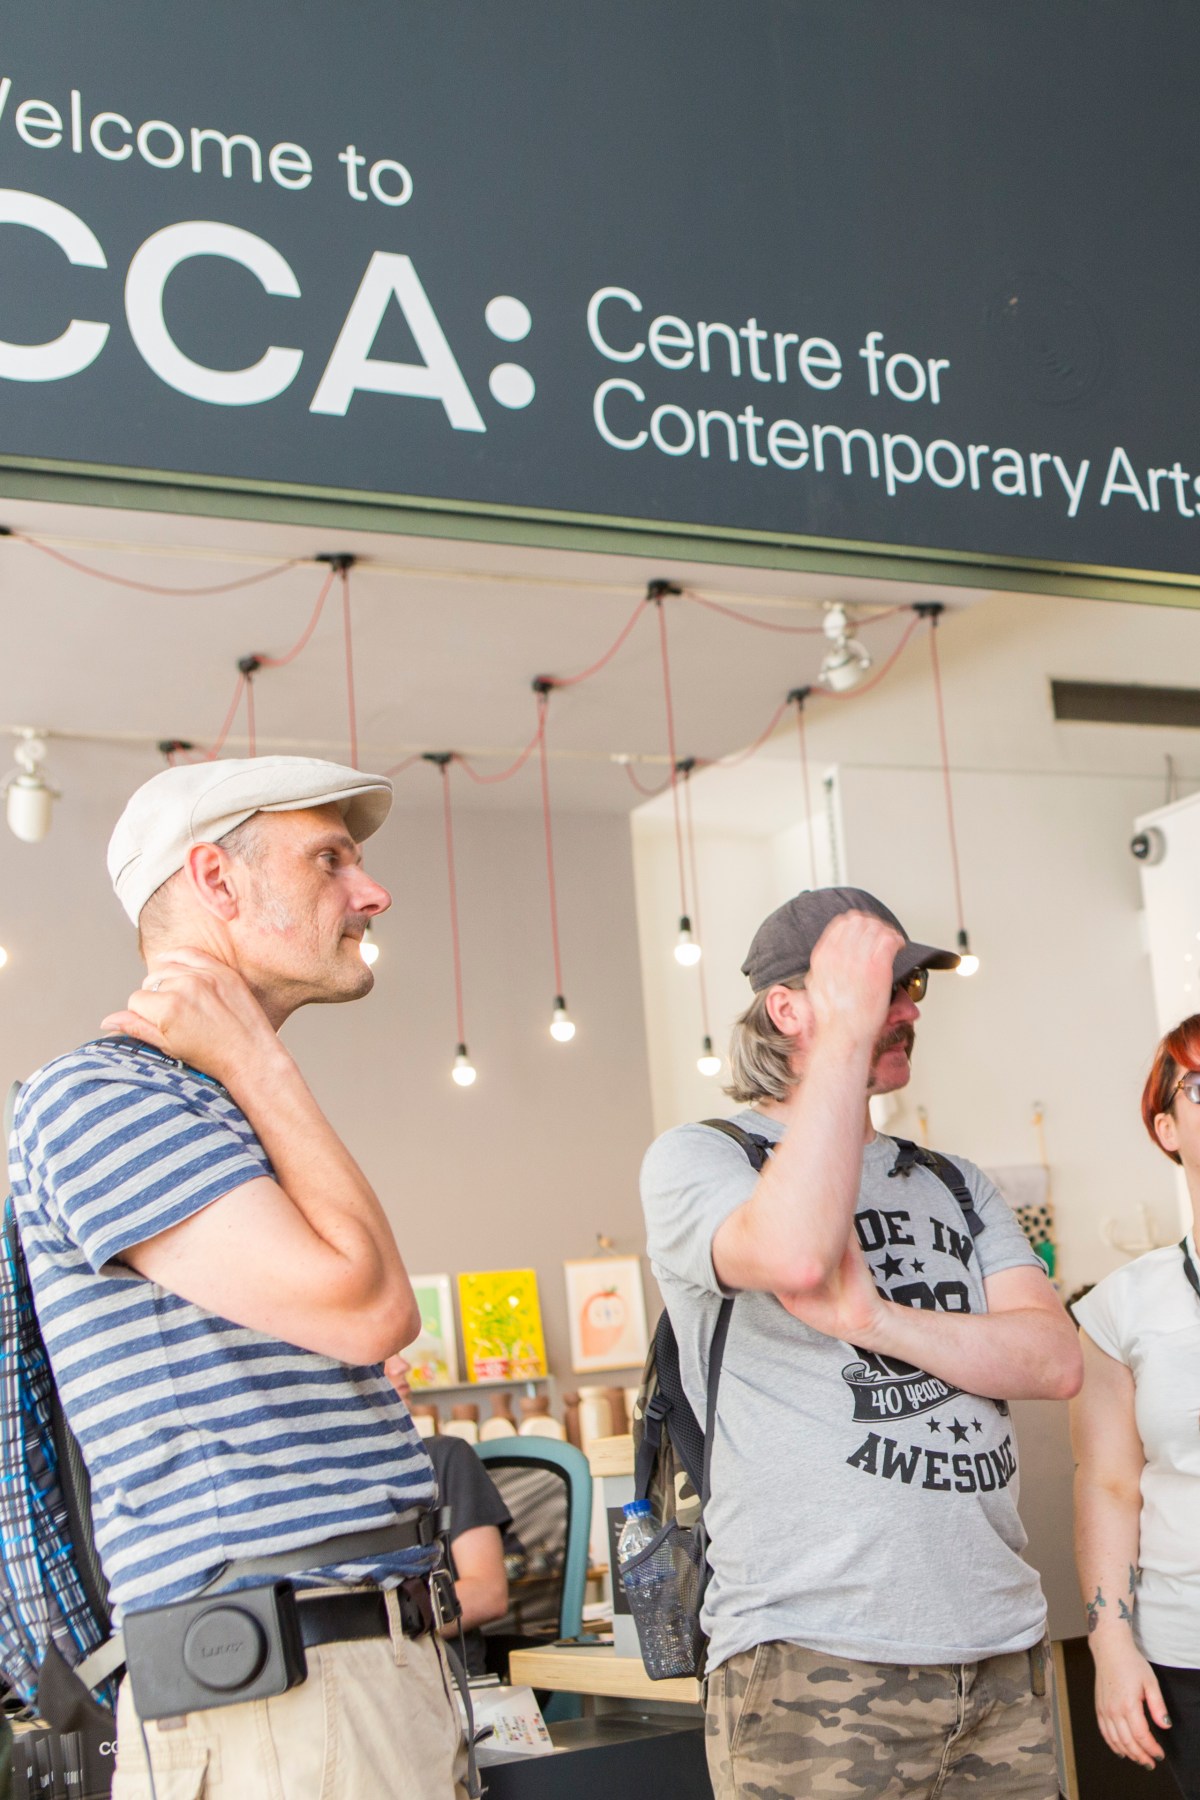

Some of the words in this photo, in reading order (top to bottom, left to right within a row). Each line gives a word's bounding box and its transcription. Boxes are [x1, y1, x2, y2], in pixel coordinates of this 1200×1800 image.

[0, 77, 313, 190] elcome
[338, 144, 413, 207] to
[0, 188, 536, 433] CCA:
[586, 286, 843, 390] Centre
[858, 331, 950, 404] for
[592, 377, 1090, 518] Contemporary
[854, 1208, 916, 1253] DE
[929, 1216, 974, 1272] IN
[871, 1385, 903, 1416] 40
[903, 1377, 949, 1410] years
[846, 1431, 1017, 1494] AWESOME
